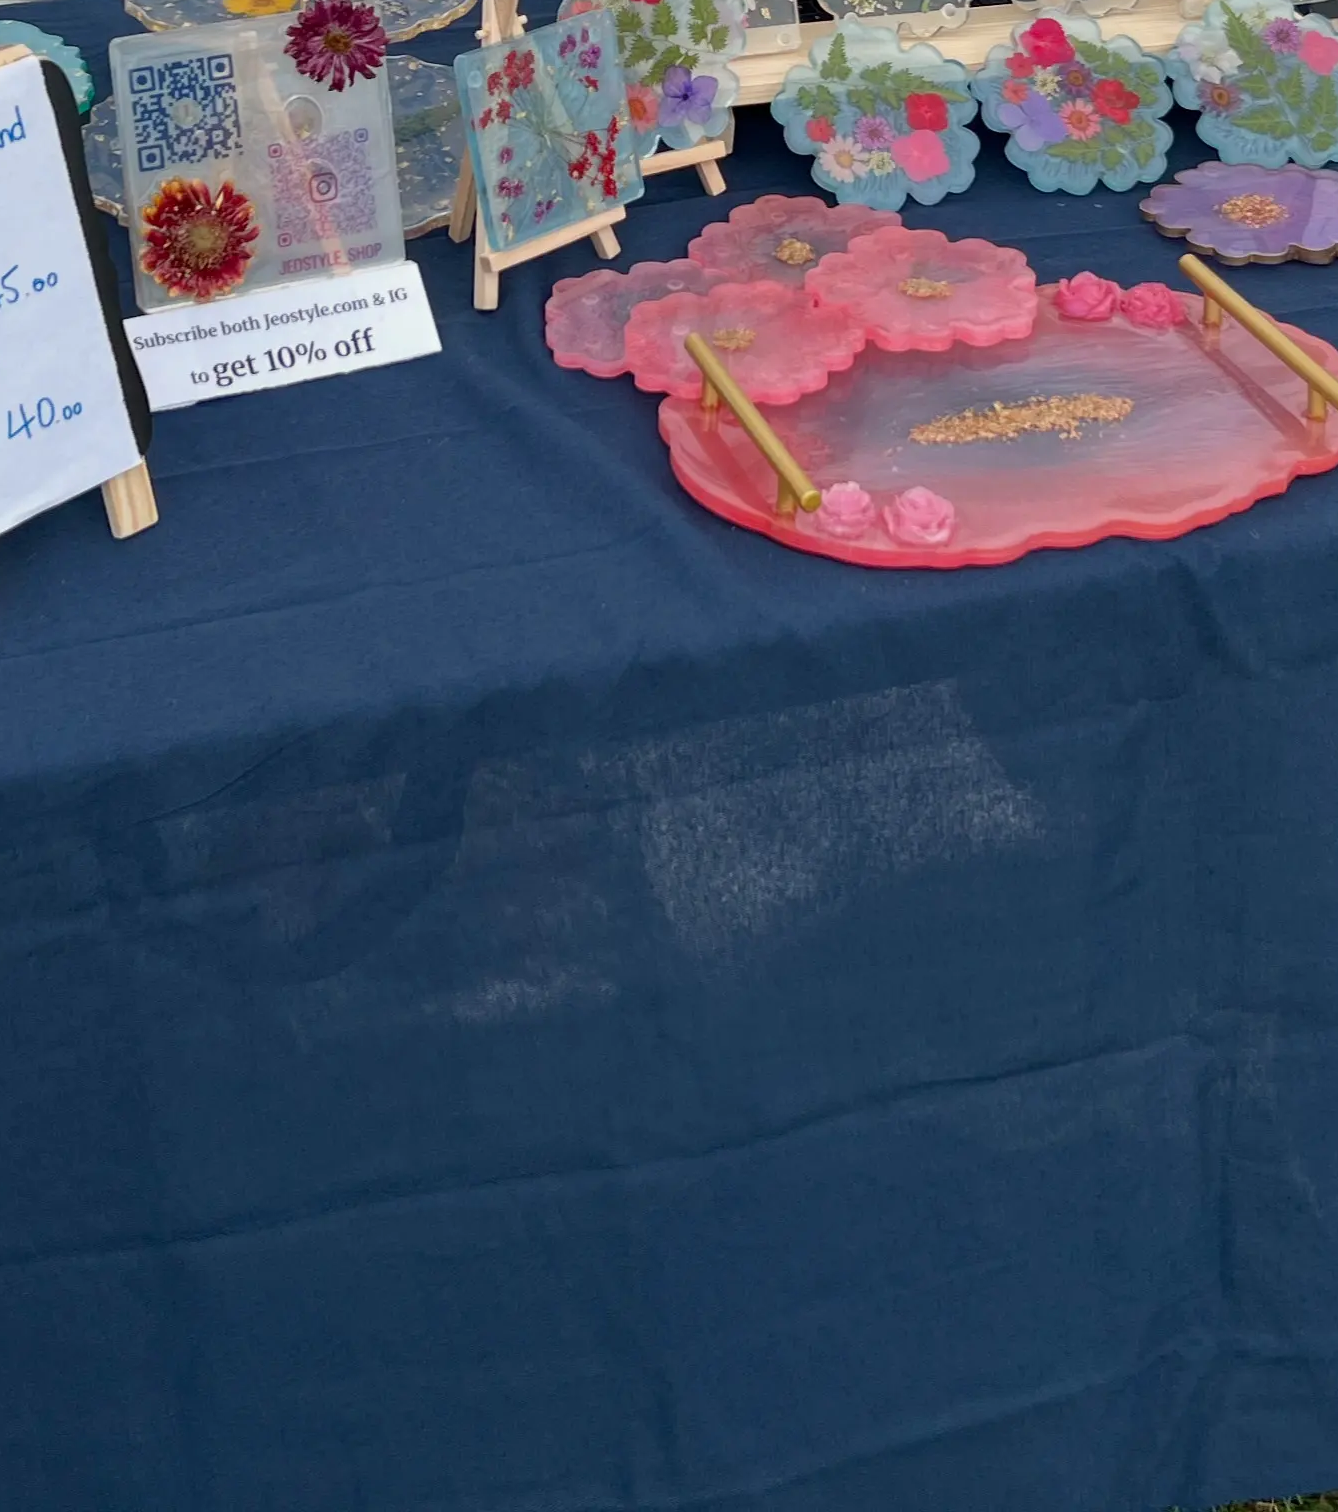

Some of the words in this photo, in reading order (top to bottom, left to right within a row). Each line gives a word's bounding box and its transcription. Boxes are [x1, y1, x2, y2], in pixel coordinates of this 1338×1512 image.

[132, 320, 218, 351] Subscribe
[220, 314, 262, 337] both
[263, 297, 369, 331] Jeostyle.com
[372, 292, 386, 307] &
[388, 287, 409, 304] IG
[191, 370, 210, 385] to
[213, 353, 260, 388] get
[263, 340, 328, 373] 10%
[334, 326, 377, 358] off
